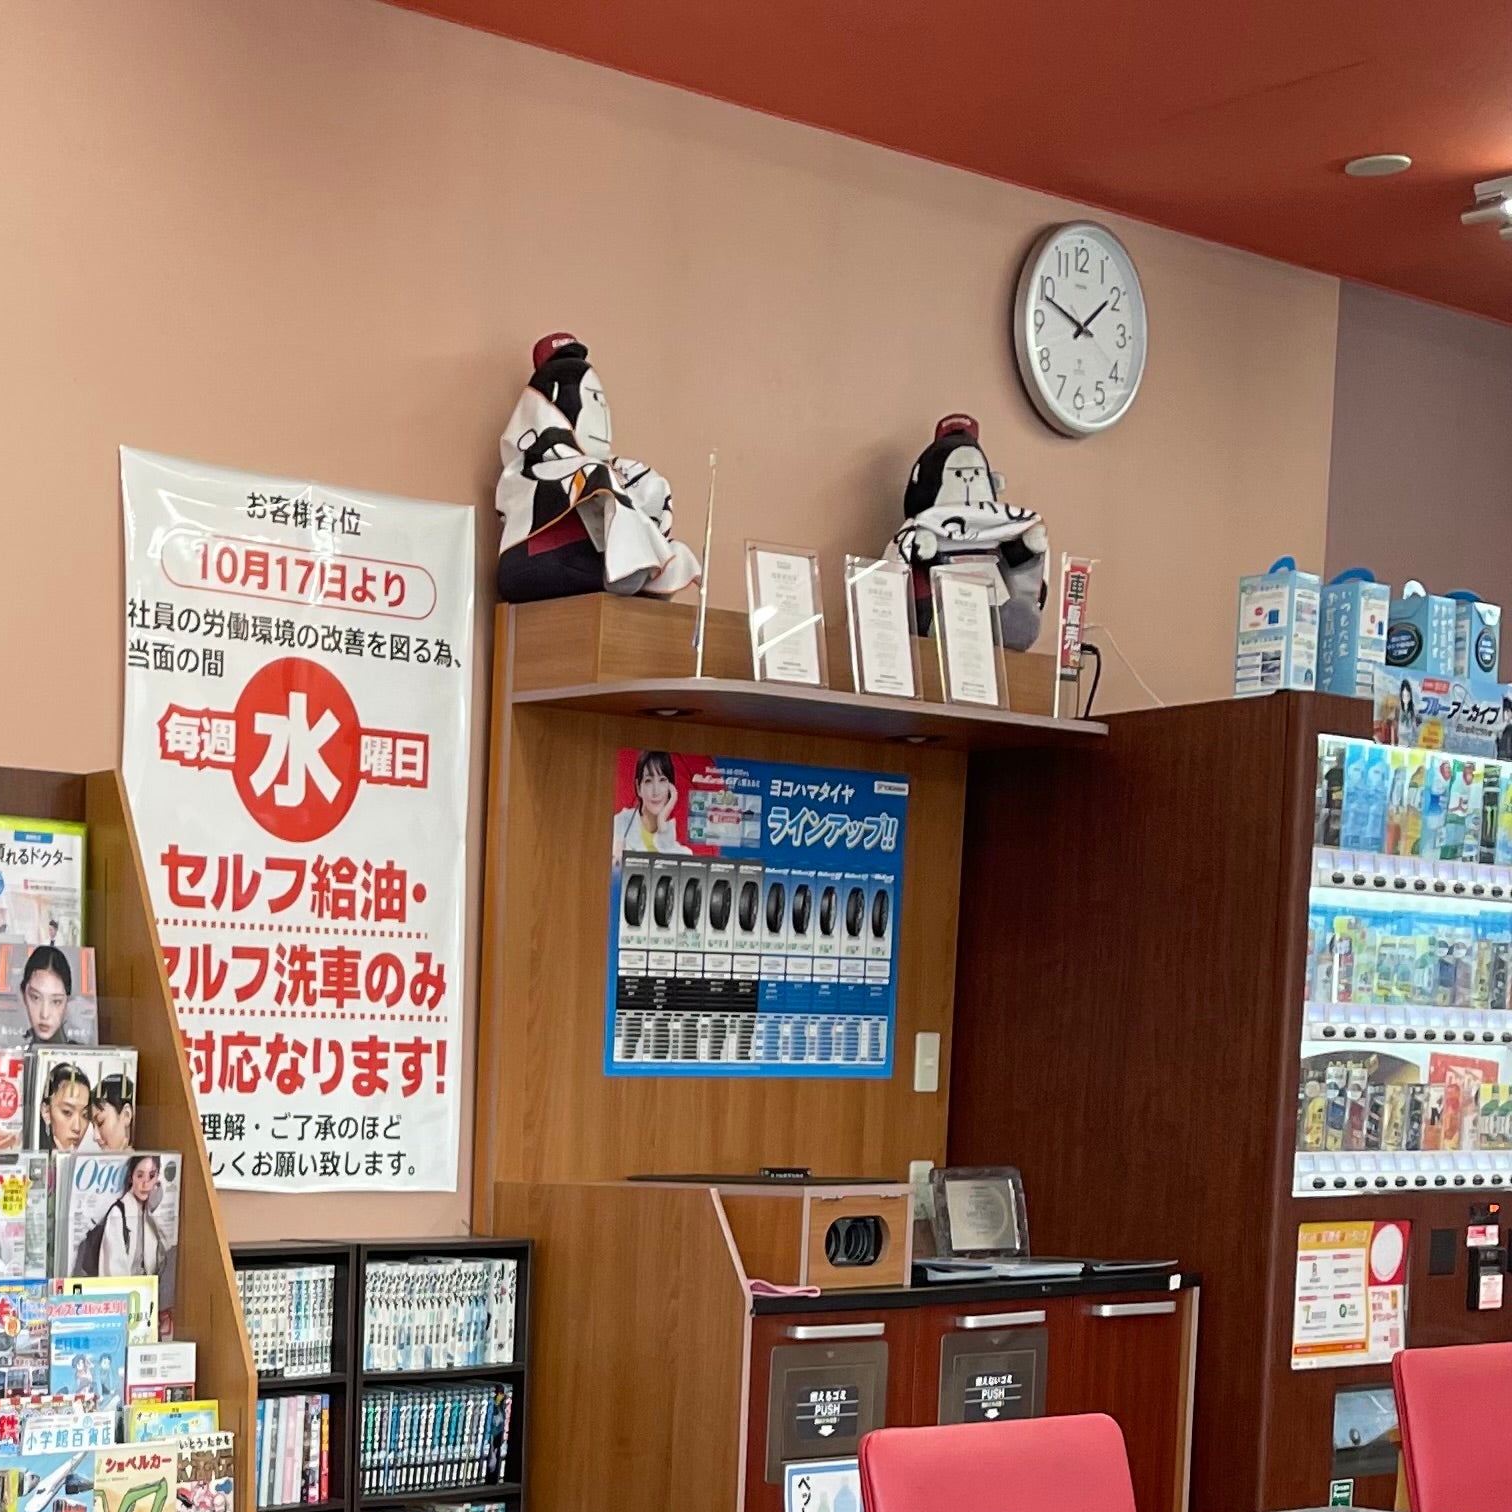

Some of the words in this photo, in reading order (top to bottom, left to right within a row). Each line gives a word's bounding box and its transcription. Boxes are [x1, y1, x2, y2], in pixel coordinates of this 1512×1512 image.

[1055, 248, 1069, 278] 11
[1075, 246, 1090, 274] 12
[1040, 275, 1056, 301] 10
[1109, 286, 1121, 312] 2
[1034, 309, 1045, 334] 9
[1115, 323, 1127, 349] 3
[1039, 347, 1051, 373] 8
[1108, 360, 1119, 384] 4
[1056, 375, 1067, 400] 7
[1072, 386, 1085, 410] 6
[1093, 381, 1106, 406] 5
[246, 491, 362, 537] お客様各位
[198, 543, 406, 608] 10月17日より
[127, 597, 463, 670] 社員の労働環境の改善を図る為、
[127, 638, 225, 678] 当面の間
[769, 778, 856, 805] ヨコハマタイヤ
[161, 942, 448, 1012] セルフ洗車のみ
[181, 1029, 447, 1098] 対応なります!
[981, 1387, 1005, 1400] PUSH
[814, 1403, 841, 1417] PUSH
[26, 1426, 112, 1452] 小学館百貨店
[105, 1453, 172, 1474] ショベルカー
